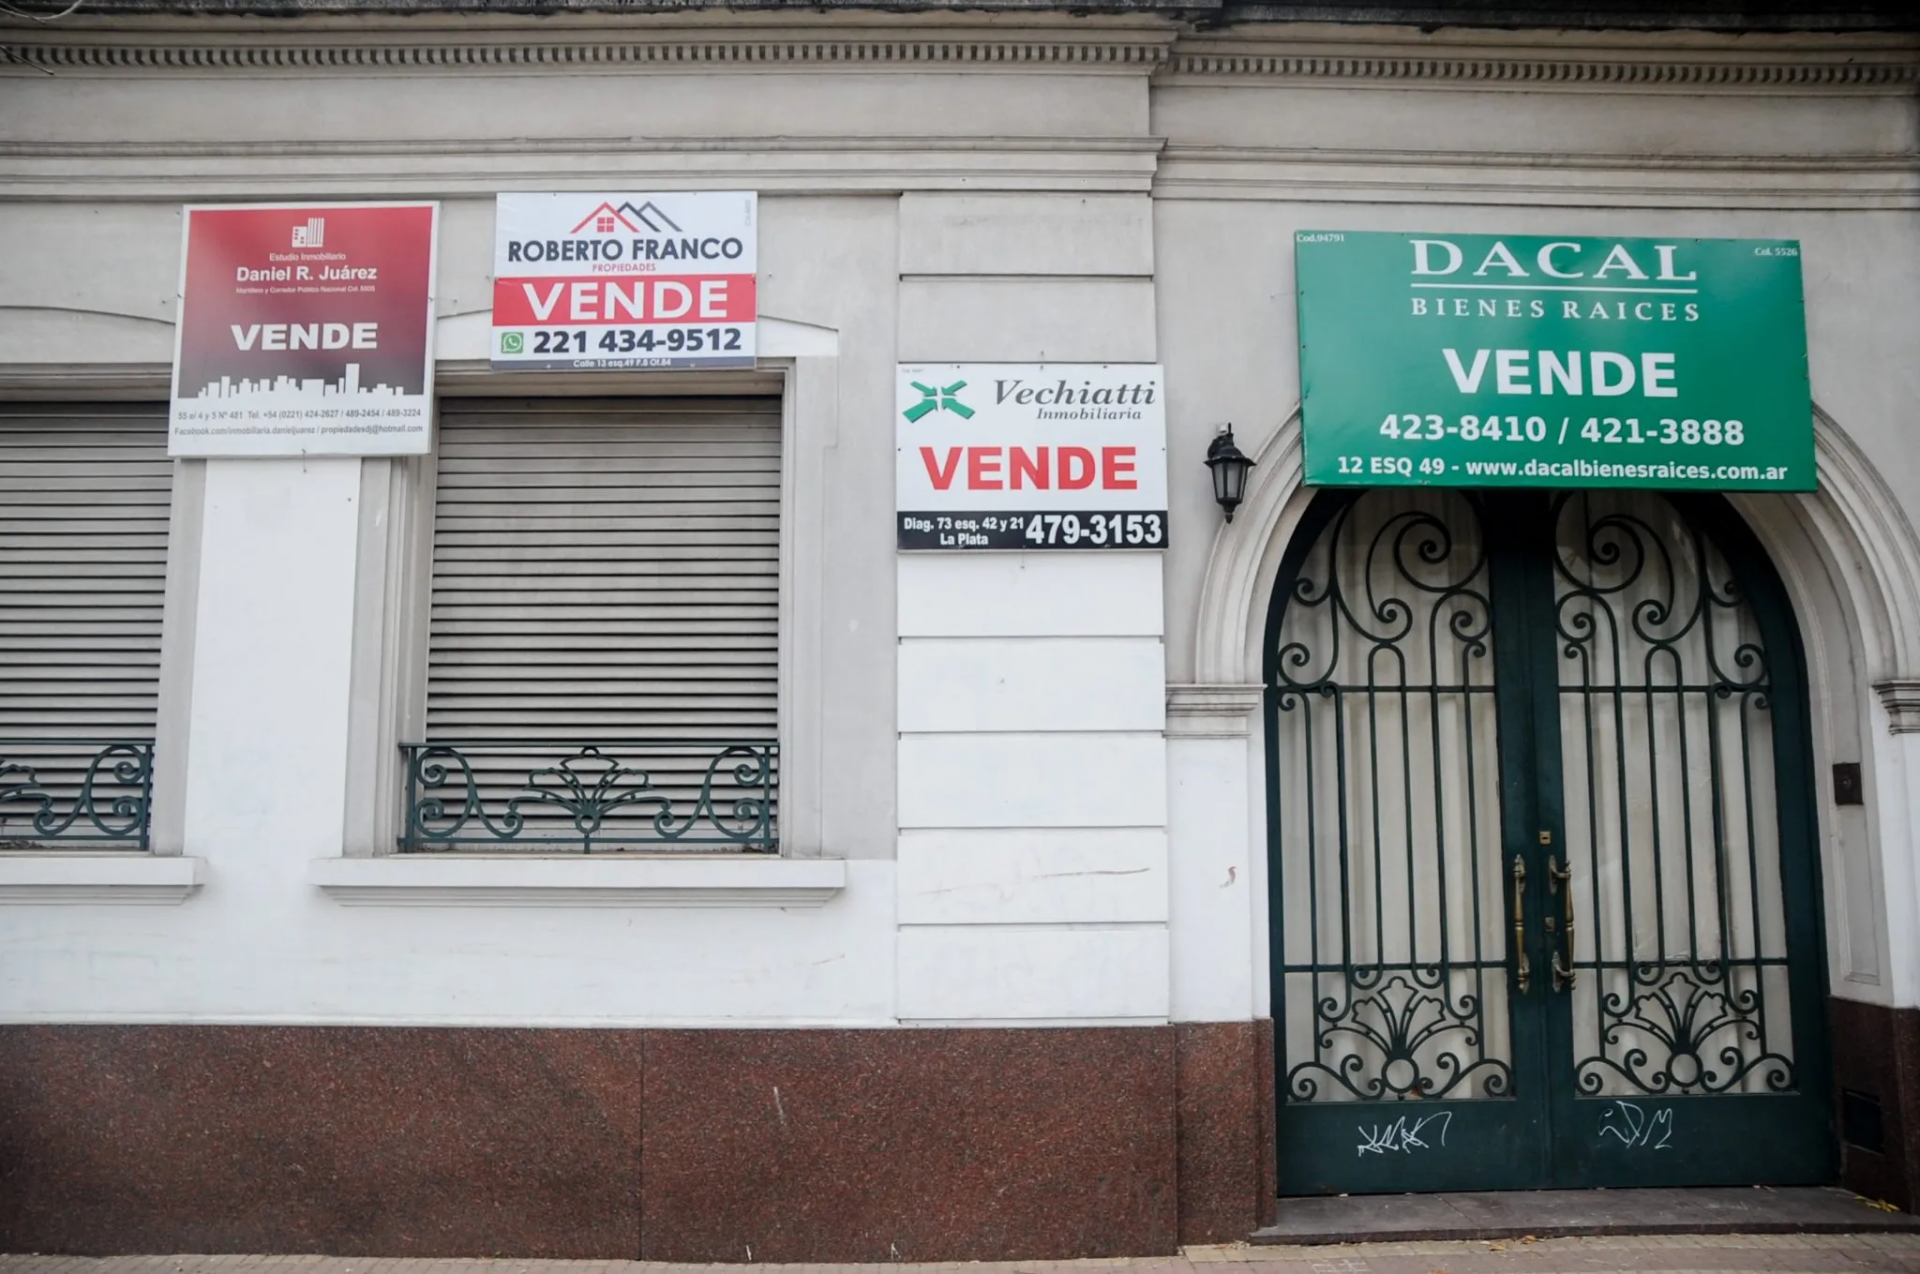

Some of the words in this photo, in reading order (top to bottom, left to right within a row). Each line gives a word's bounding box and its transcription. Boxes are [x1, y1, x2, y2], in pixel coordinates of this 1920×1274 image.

[269, 252, 299, 262] Estudio
[301, 252, 346, 261] Inmobiliario
[508, 239, 624, 262] ROBERTO
[632, 237, 743, 260] FRANCO
[1409, 239, 1697, 281] DACAL
[1775, 247, 1798, 256] 5526
[236, 265, 291, 281] Daniel
[296, 265, 314, 280] R.
[318, 264, 378, 280] Juárez
[592, 263, 656, 272] PROPIEDADES
[522, 281, 728, 321] VENDE
[1411, 298, 1545, 318] BIENES
[1562, 300, 1699, 321] RAICES
[230, 322, 379, 351] VENDE
[533, 331, 587, 353] 221
[598, 328, 742, 352] 434-9512
[573, 359, 595, 368] Calle
[597, 359, 607, 368] 13
[1442, 348, 1678, 397] VENDE
[994, 379, 1156, 405] Vechiatti
[247, 410, 260, 419] Tel.
[263, 410, 277, 419] +54
[279, 409, 303, 420] (0221)
[345, 408, 380, 418] 489-2454
[386, 408, 421, 418] 489-3224
[1036, 407, 1142, 420] Inmobiliaria
[1379, 414, 1547, 442] 423-8410
[1558, 417, 1569, 444] /
[1580, 417, 1745, 446] 421-3888
[919, 446, 1138, 490] VENDE
[1338, 456, 1363, 474] 12
[1370, 456, 1413, 477] ESQ
[1419, 457, 1445, 475] 49
[1466, 458, 1788, 480] www.dacalbienesraices.com.ar
[904, 517, 934, 531] Diag.
[937, 517, 952, 529] 73
[955, 518, 980, 531] esq.
[982, 517, 997, 529] 42
[1000, 520, 1008, 532] y
[1010, 517, 1024, 529] 21
[1025, 514, 1162, 545] 479-3153
[940, 533, 955, 546] La
[958, 532, 989, 546] Plata
